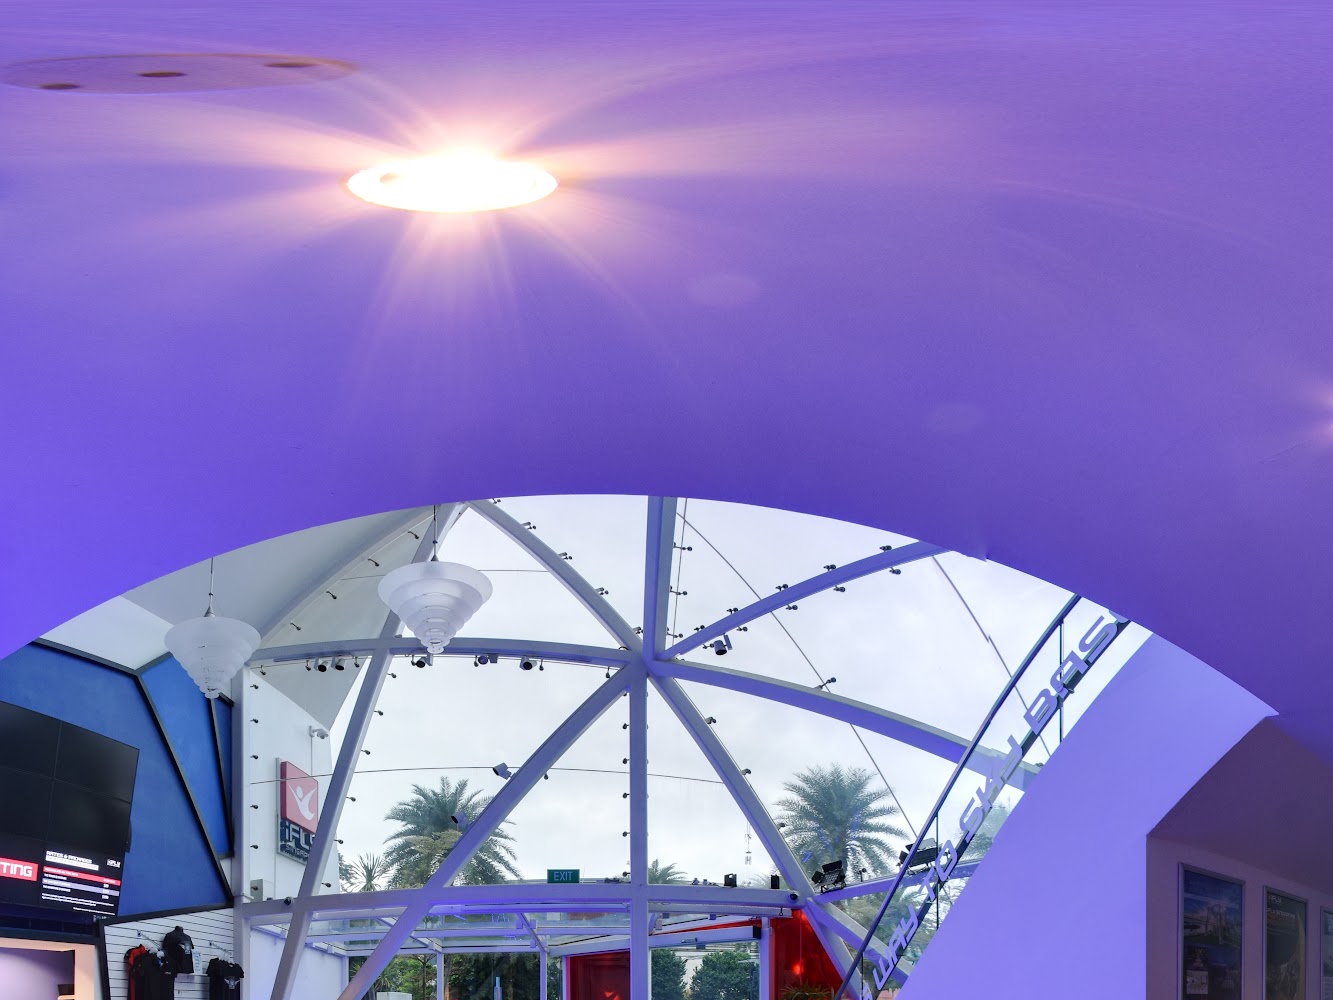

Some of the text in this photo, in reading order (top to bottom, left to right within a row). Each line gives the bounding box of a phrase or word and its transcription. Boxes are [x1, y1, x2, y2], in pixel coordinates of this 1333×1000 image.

[872, 904, 918, 990] WAY
[918, 839, 958, 901] TO
[959, 734, 1023, 843] SKY
[1023, 609, 1129, 735] BAS
[286, 821, 315, 850] iFL
[0, 861, 33, 878] TING
[553, 871, 573, 881] EXIT
